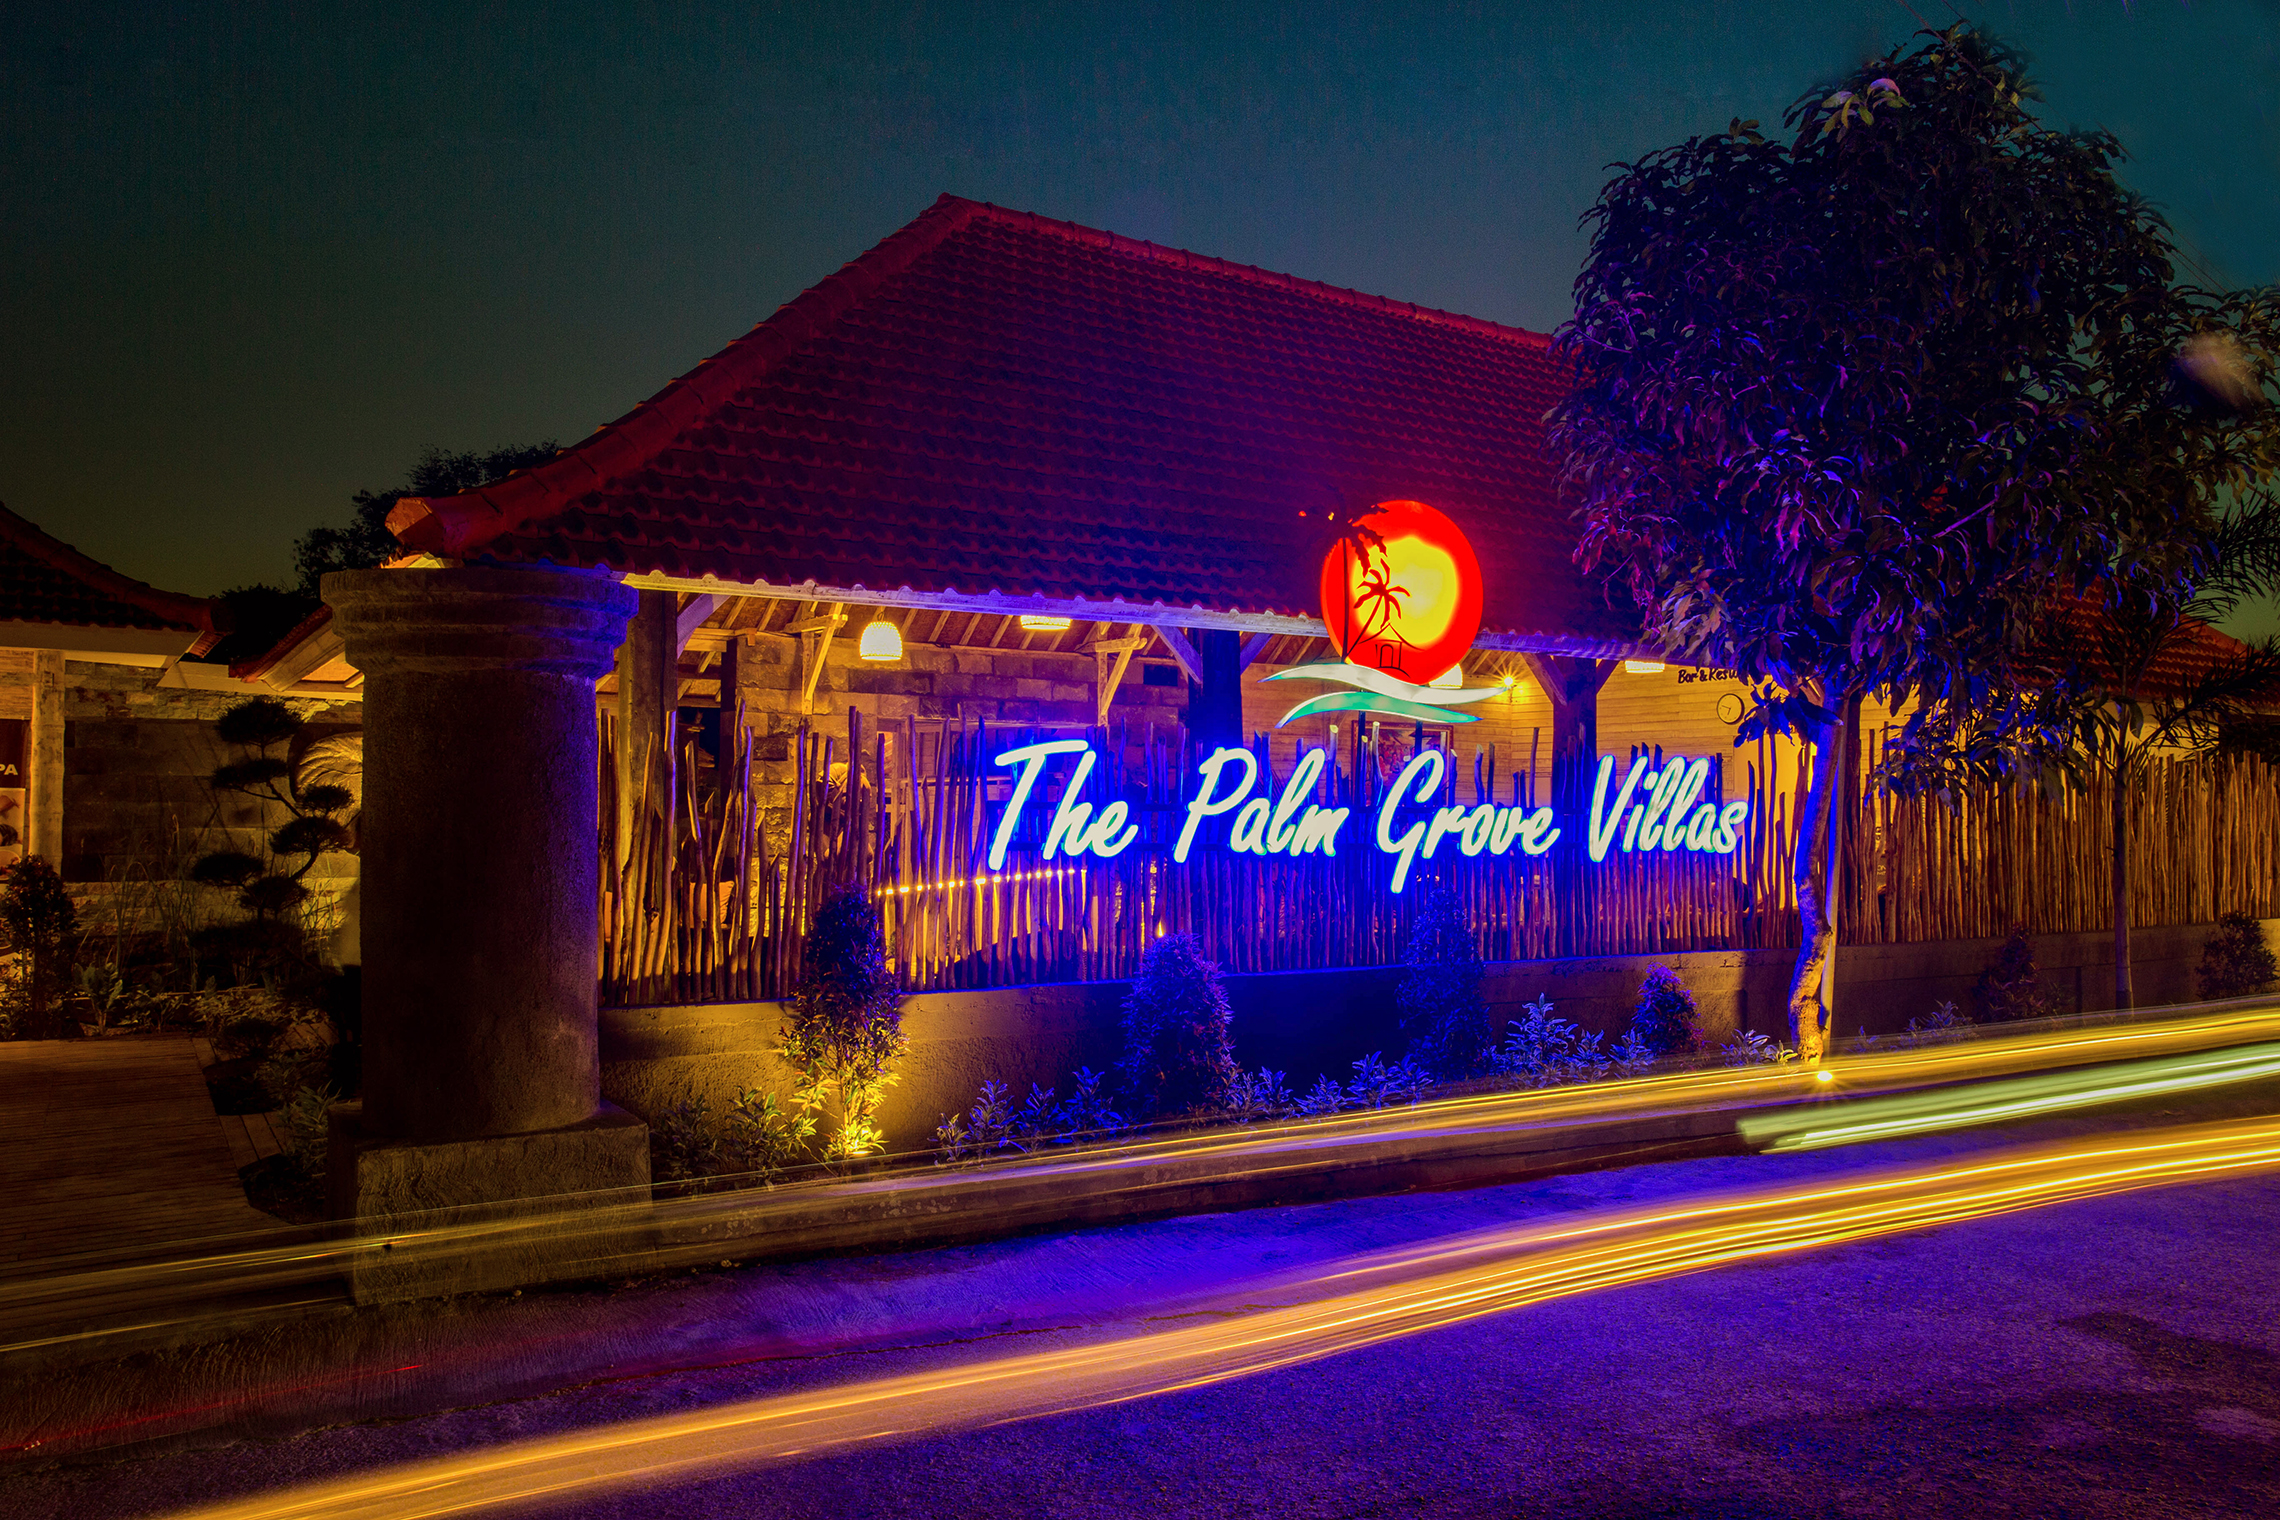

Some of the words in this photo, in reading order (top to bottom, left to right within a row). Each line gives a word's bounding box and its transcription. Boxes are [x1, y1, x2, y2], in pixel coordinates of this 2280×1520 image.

[1699, 669, 1708, 682] &
[987, 739, 1140, 871] The
[1173, 747, 1351, 863] Palm
[1377, 749, 1561, 893] Grove
[1588, 755, 1749, 862] Villas
